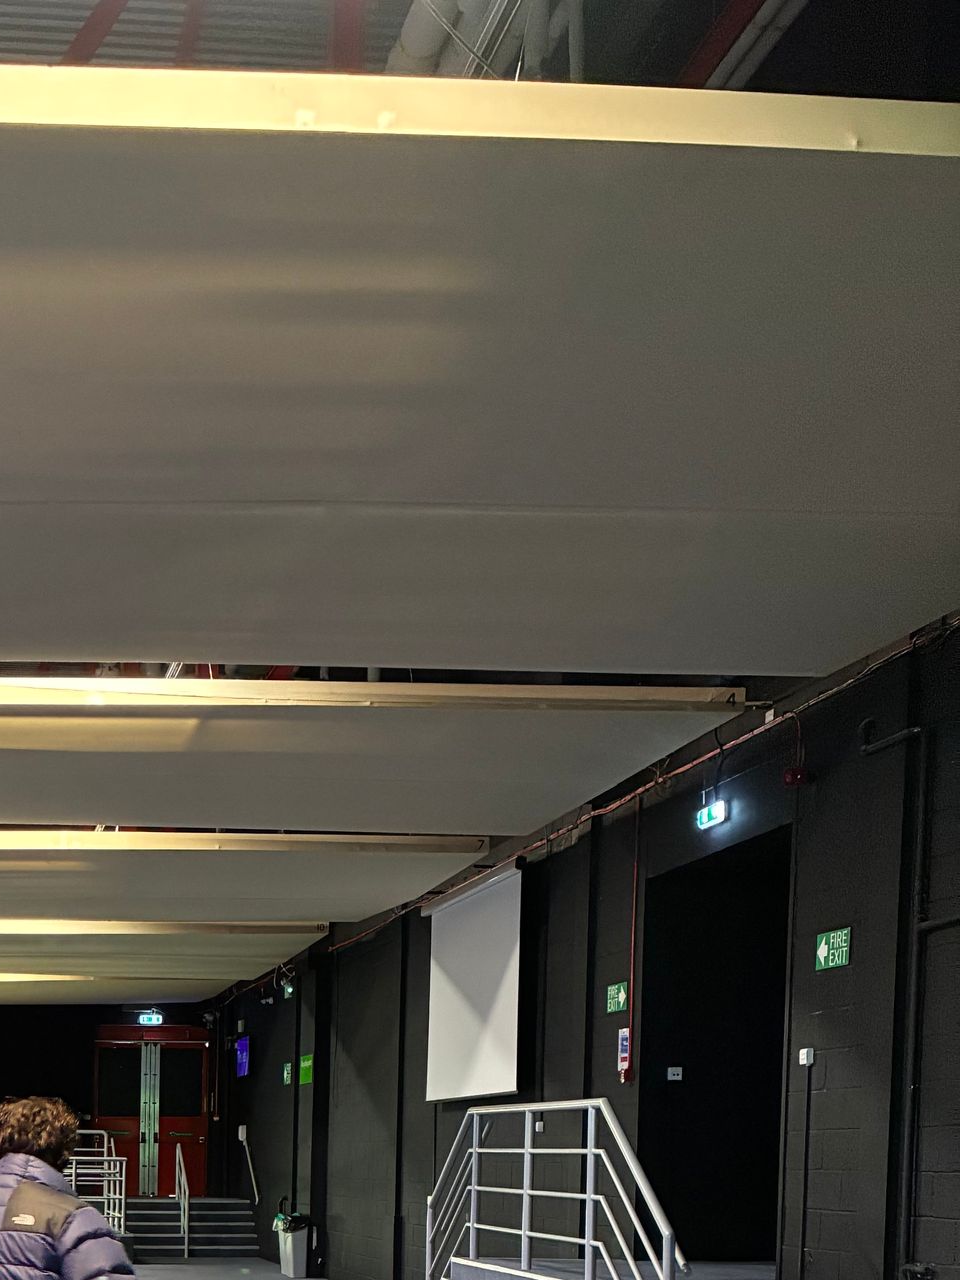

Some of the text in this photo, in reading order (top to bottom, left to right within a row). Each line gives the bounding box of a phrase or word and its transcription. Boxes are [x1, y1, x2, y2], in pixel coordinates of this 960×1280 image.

[725, 692, 736, 707] 4
[477, 839, 485, 850] 7
[829, 930, 848, 949] FIRE
[829, 947, 848, 966] EXIT
[607, 984, 618, 1000] FIRE
[607, 998, 618, 1012] EXIT
